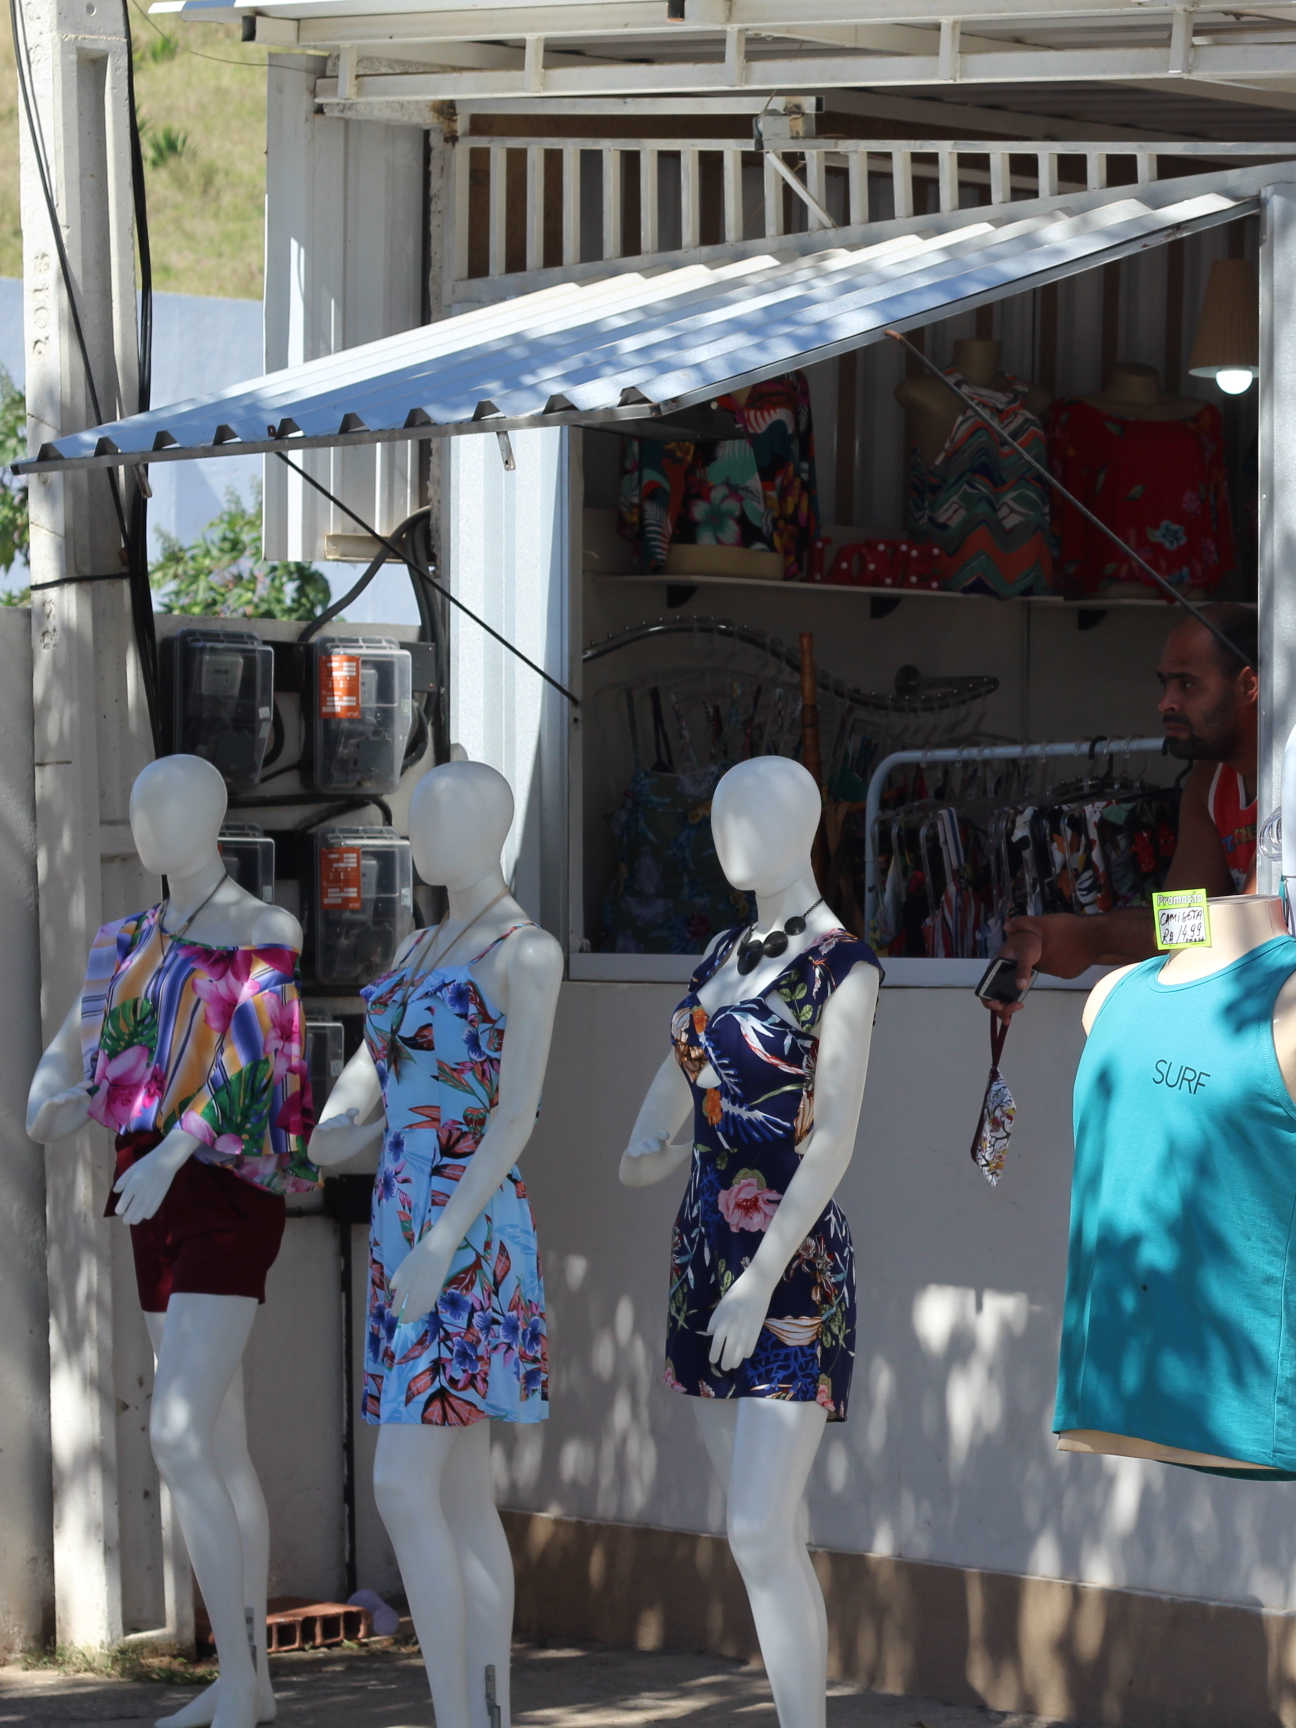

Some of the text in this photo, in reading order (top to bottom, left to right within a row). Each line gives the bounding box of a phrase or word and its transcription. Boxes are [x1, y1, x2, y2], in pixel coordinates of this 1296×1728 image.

[801, 537, 941, 589] LOVE
[1157, 891, 1203, 907] Promoção
[1160, 909, 1203, 926] CAMISETA
[1152, 1059, 1211, 1094] SURF
